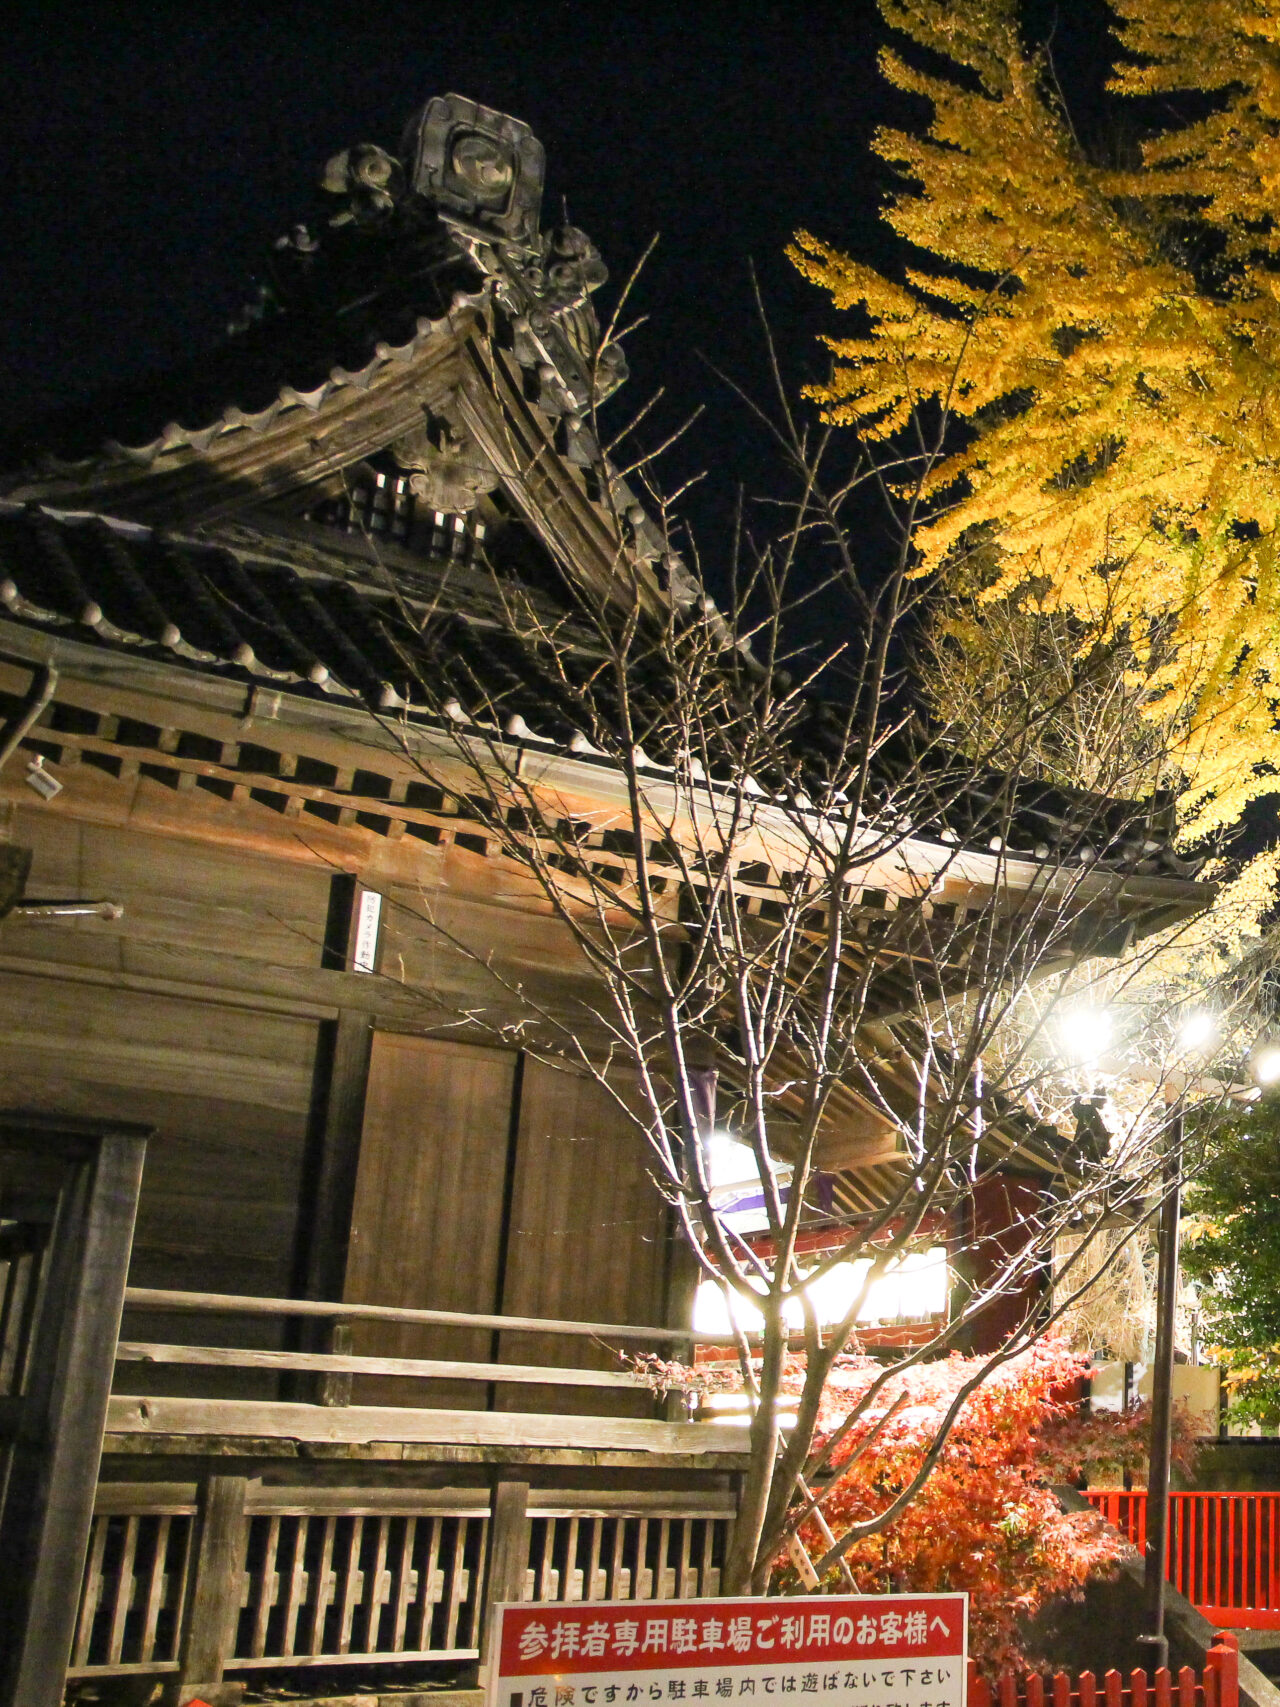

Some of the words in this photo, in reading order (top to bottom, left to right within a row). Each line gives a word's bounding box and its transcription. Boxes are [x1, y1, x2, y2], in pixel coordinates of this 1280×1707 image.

[519, 1611, 951, 1661] 参拝者専用駐車場ご利用のお客様へ
[527, 1668, 952, 1707] 危険ですから駐車場内では遊ばないで下さい
